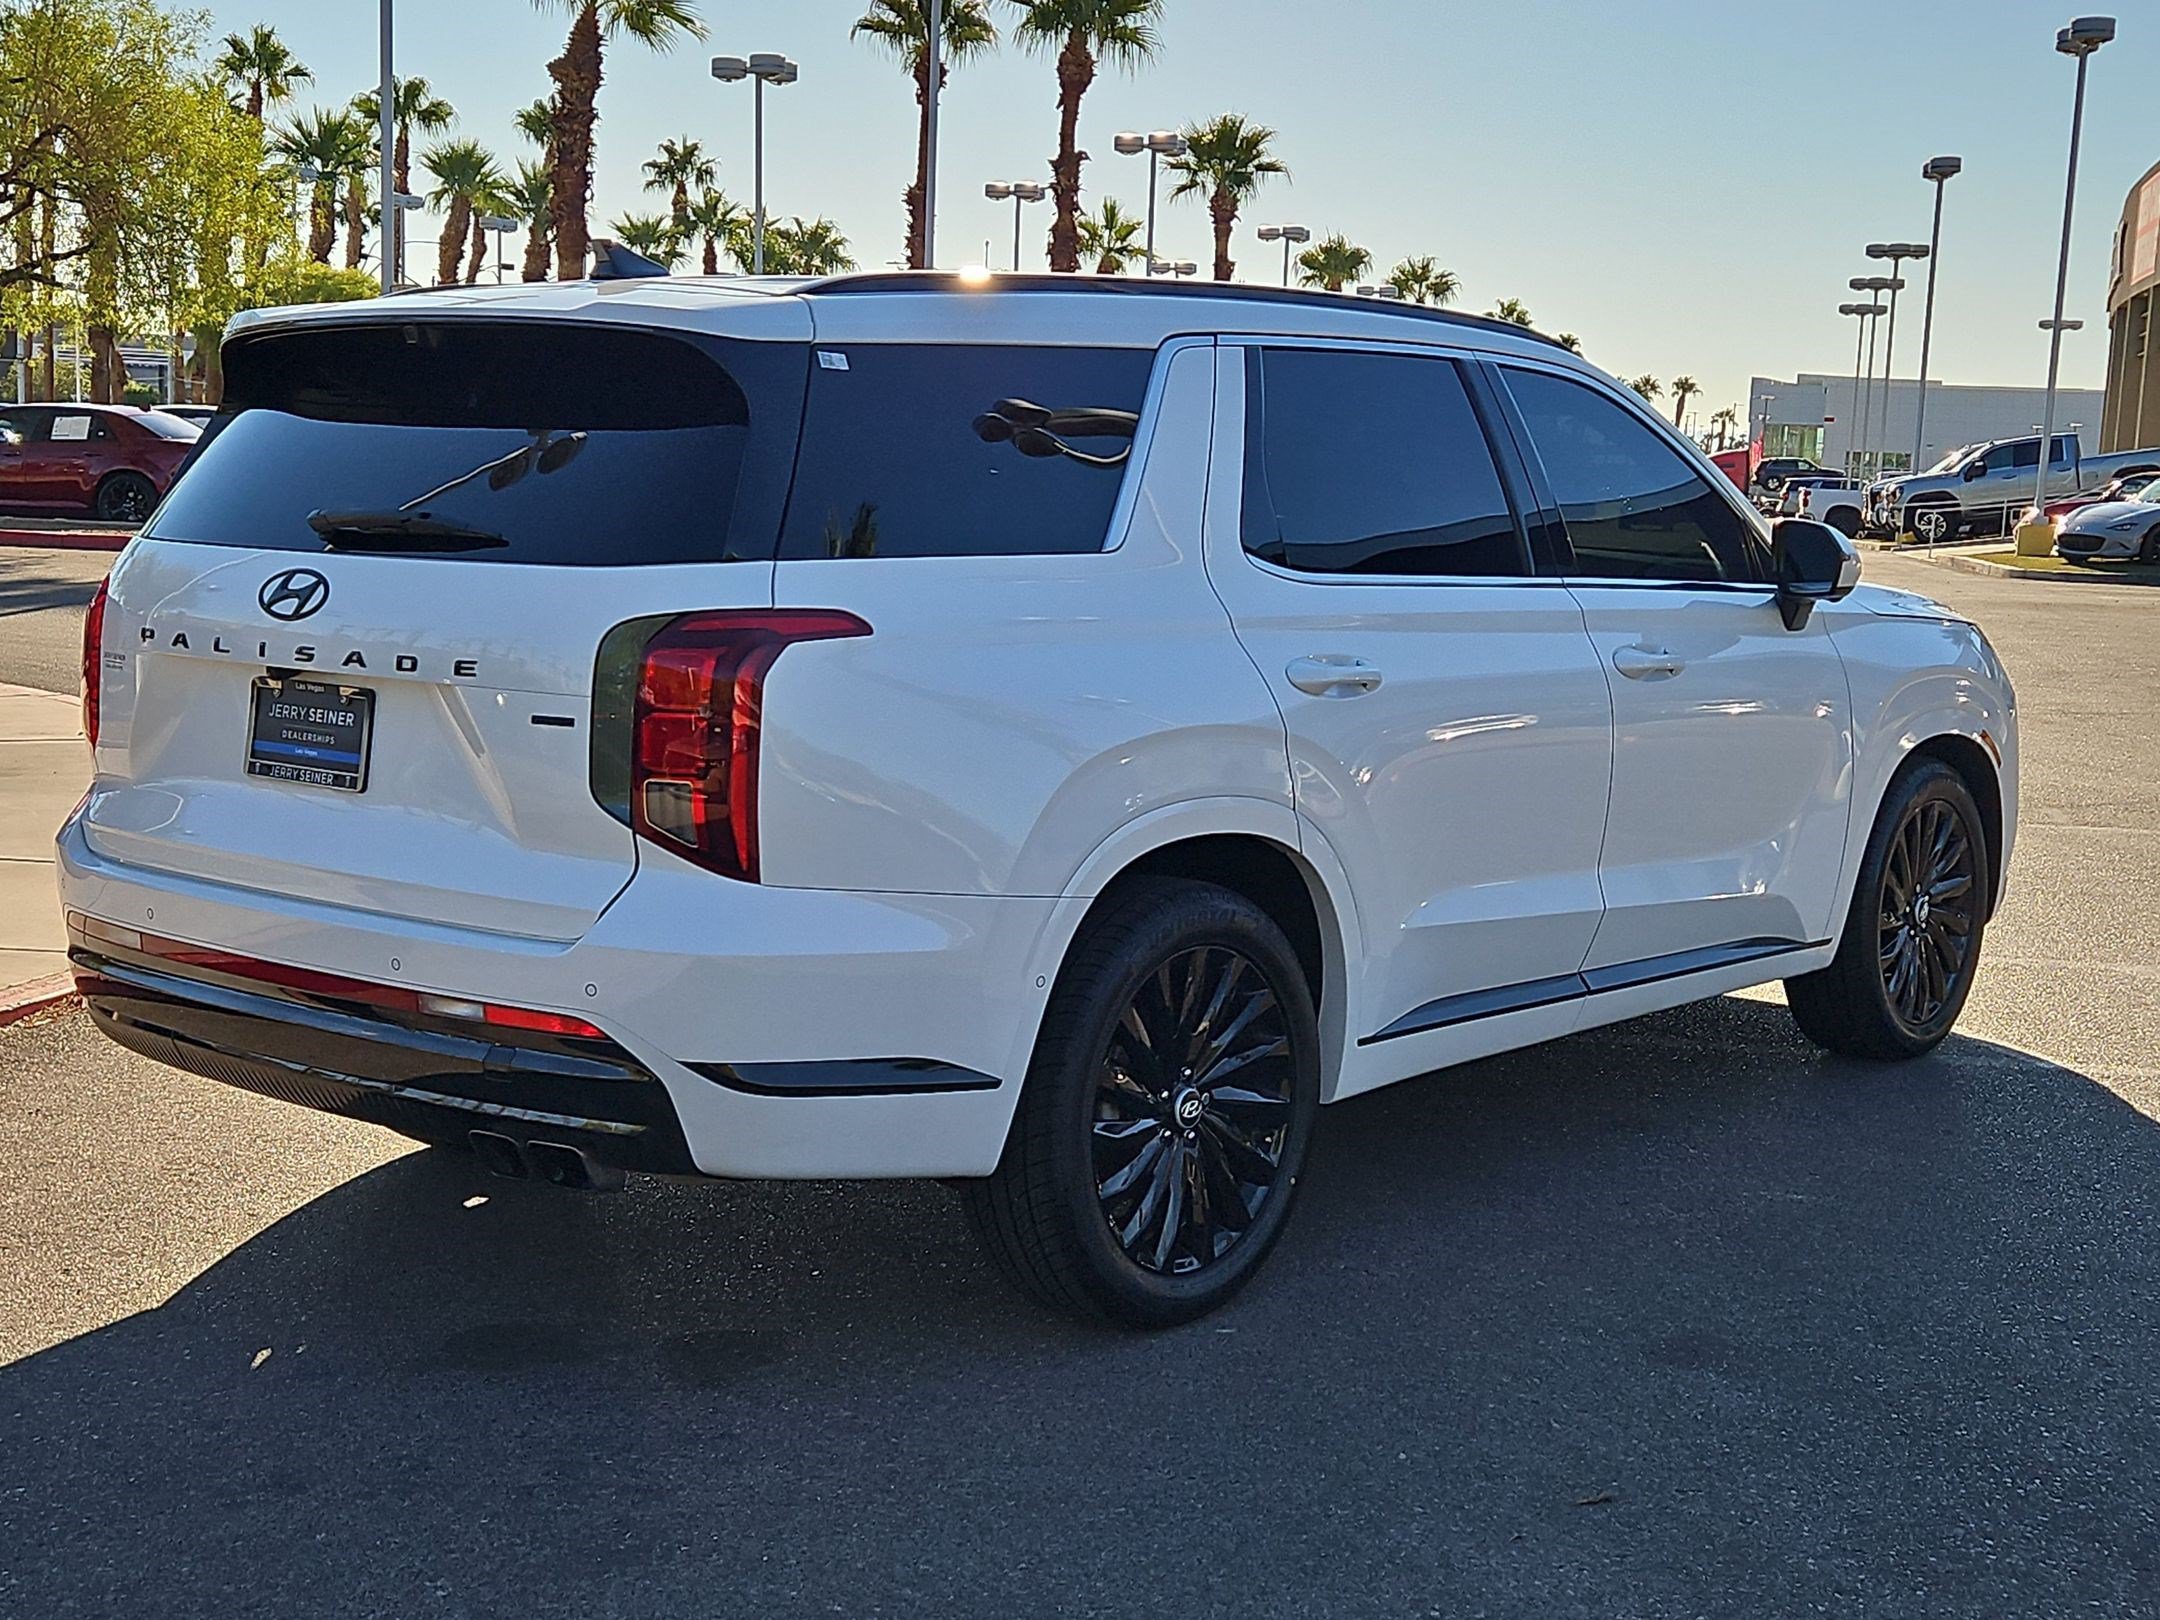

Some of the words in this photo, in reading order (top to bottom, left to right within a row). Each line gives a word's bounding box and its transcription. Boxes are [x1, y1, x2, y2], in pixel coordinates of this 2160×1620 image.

[141, 627, 478, 677] PALISADE
[295, 682, 306, 690] Las
[306, 683, 325, 693] Vegas
[269, 704, 307, 720] JERRY
[308, 708, 355, 727] SEINER
[282, 730, 335, 745] DEALERSHIPS
[269, 766, 299, 780] JERRY
[299, 769, 334, 785] SEINER
